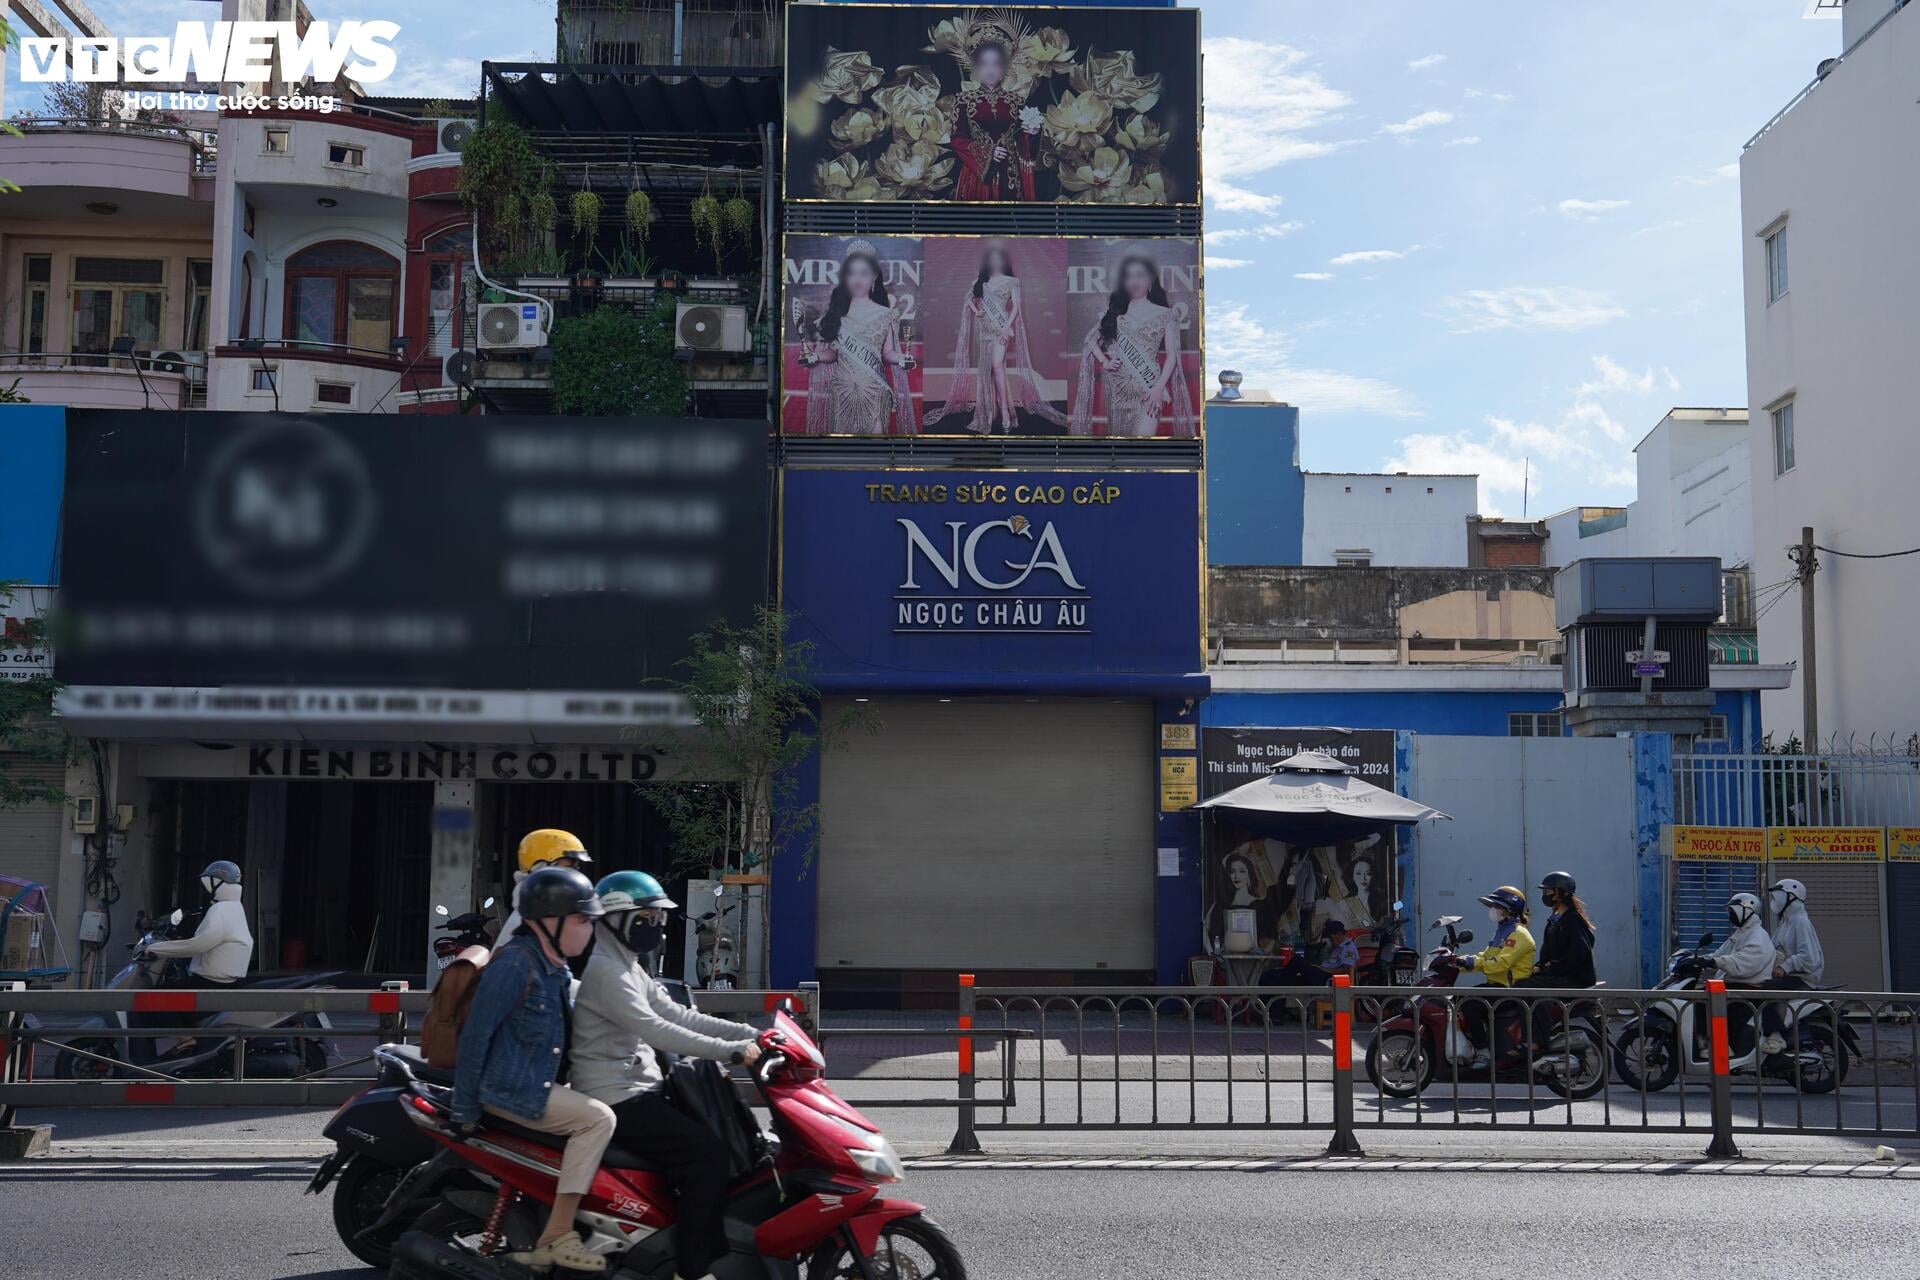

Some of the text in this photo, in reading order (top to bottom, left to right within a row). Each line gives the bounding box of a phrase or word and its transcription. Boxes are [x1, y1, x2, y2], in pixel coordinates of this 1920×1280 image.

[865, 479, 1121, 505] TRANG SỨC CAO CẤP
[899, 599, 1086, 629] NGỌC CHÂU ÂU
[1237, 744, 1263, 758] Ngọc
[1266, 744, 1293, 757] Châu
[1341, 745, 1360, 757] đón
[1207, 761, 1224, 773] Thí
[1226, 762, 1248, 774] sinh
[1252, 762, 1276, 774] Miss
[1362, 764, 1389, 775] 2024
[1691, 839, 1723, 853] NGỌC
[1743, 840, 1761, 853] 176
[1855, 836, 1875, 844] 176
[1829, 844, 1877, 852] DOOR
